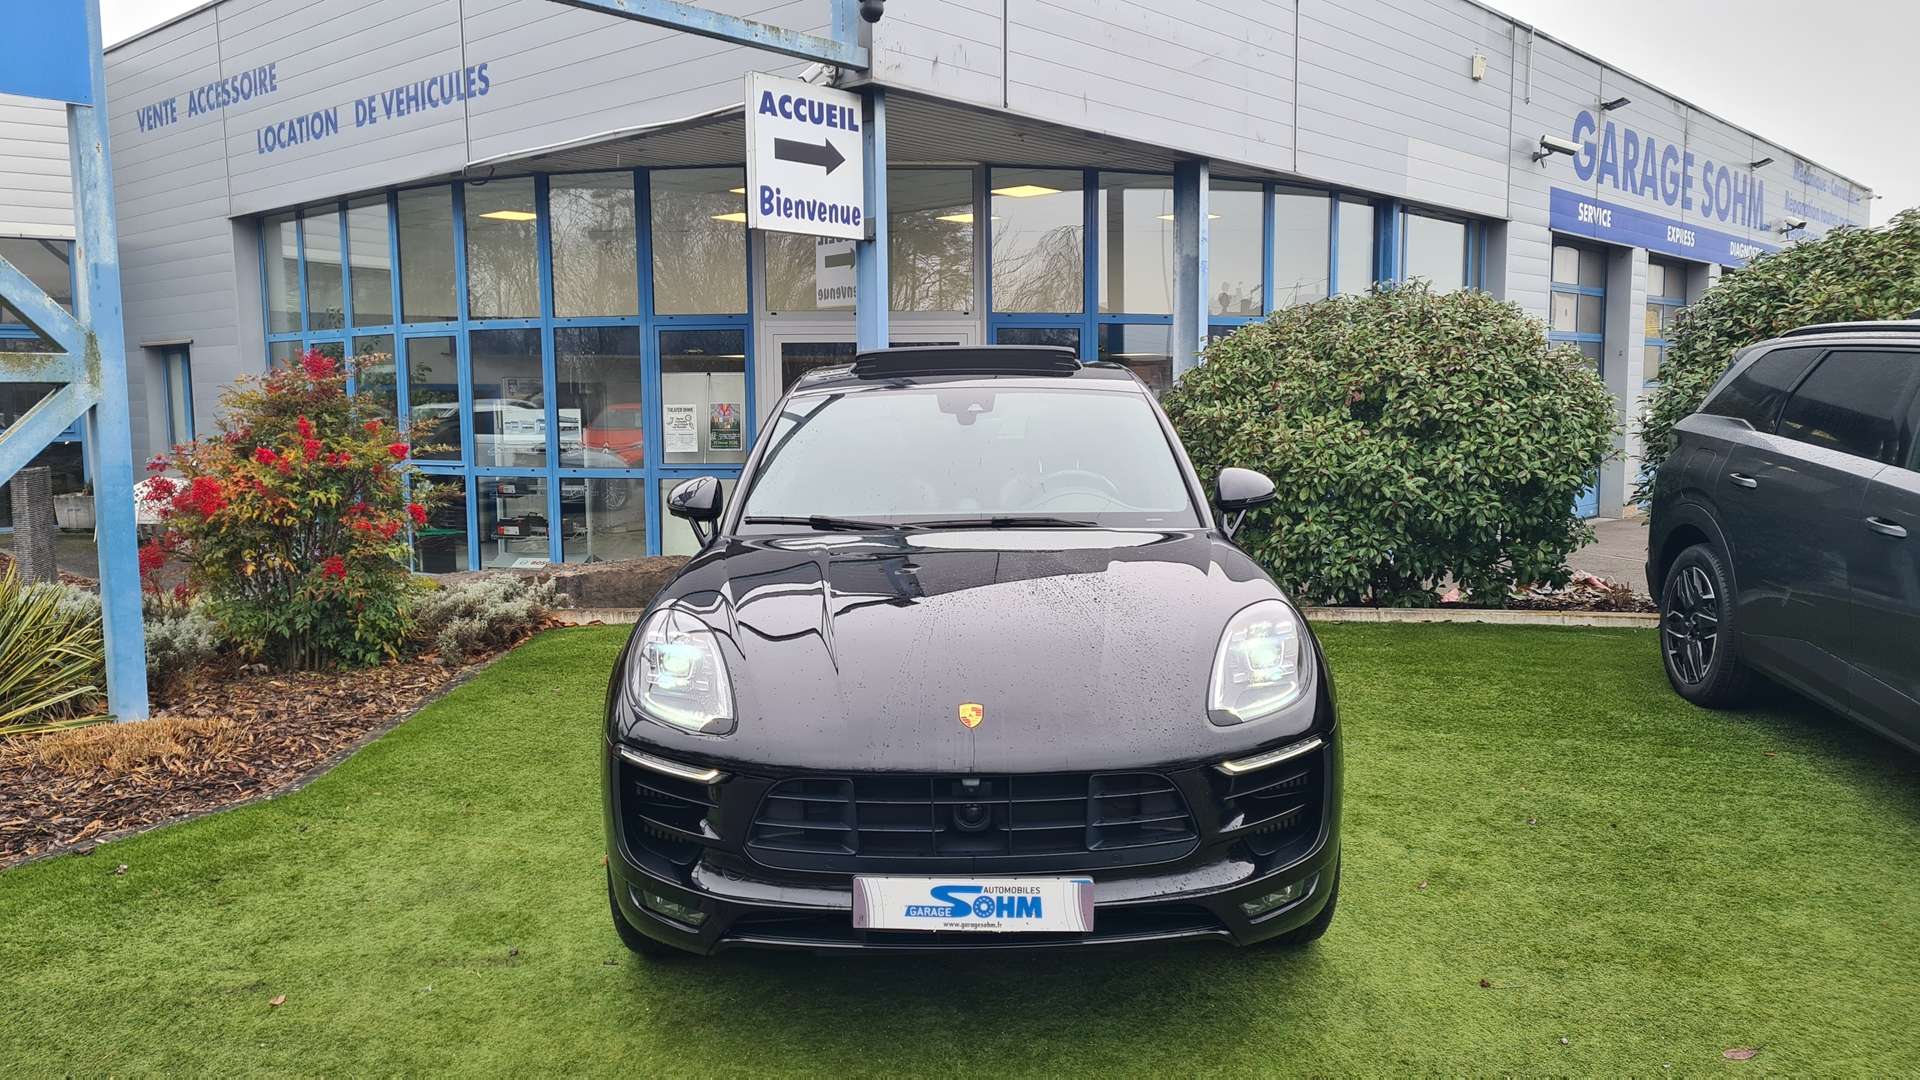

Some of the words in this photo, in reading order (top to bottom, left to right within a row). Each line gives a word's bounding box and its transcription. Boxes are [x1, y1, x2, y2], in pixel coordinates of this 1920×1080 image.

[136, 97, 178, 133] VENTE
[188, 62, 278, 118] ACCESSOIRE
[257, 106, 339, 154] LOCATION
[355, 95, 377, 127] DE
[381, 62, 490, 121] VEHICULES
[758, 90, 859, 132] ACCUEIL
[1572, 110, 1695, 211] GARAGE
[1701, 160, 1765, 229] SOHM
[759, 185, 861, 227] Bienvenue
[1578, 202, 1612, 228] SERVICE
[1667, 225, 1695, 247] EXPRESS
[930, 885, 1043, 918] SOHM
[983, 886, 1041, 895] AUTOMOBILES
[909, 907, 953, 917] GARAGE
[943, 921, 1002, 929] www.garagesohm.fr
